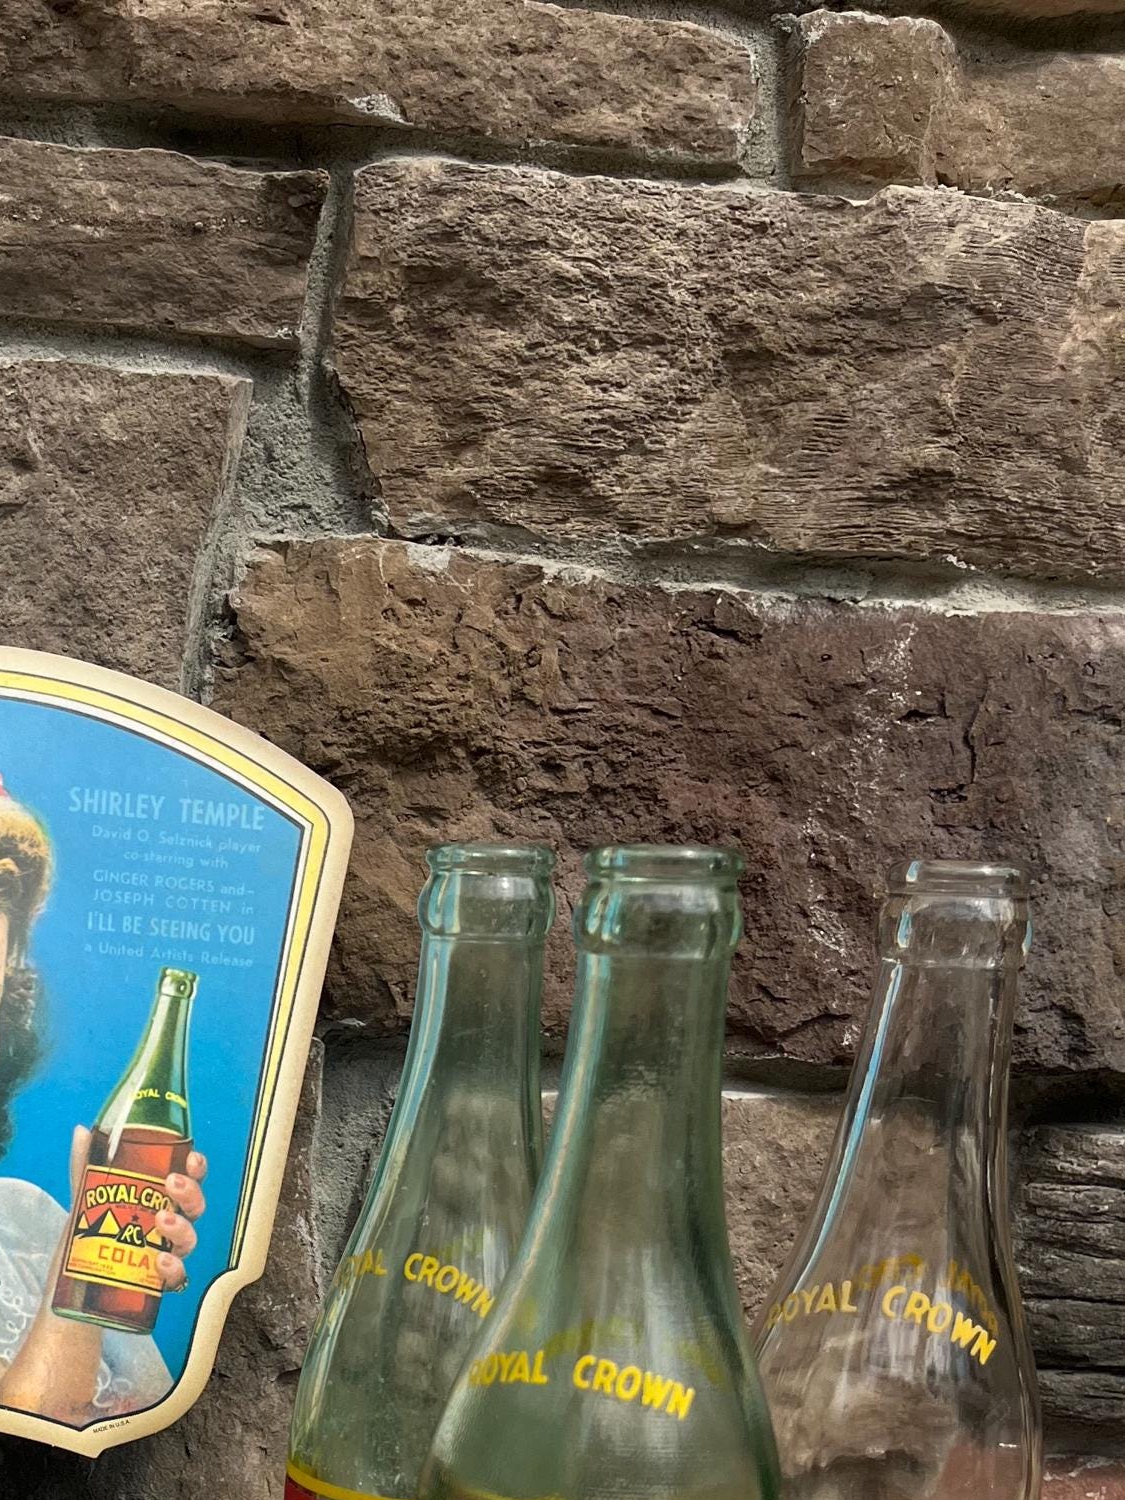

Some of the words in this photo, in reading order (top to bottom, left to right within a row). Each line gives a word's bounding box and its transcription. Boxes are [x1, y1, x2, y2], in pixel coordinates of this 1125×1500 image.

[69, 786, 165, 820] SHIRLEY
[179, 798, 266, 831] TEMPLE
[92, 825, 131, 840] David
[218, 839, 261, 854] player
[200, 856, 229, 869] with
[93, 869, 148, 886] GINGER
[154, 875, 215, 893] ROGERS
[93, 889, 155, 907] JOSEPH
[165, 897, 231, 914] COTTEN
[241, 902, 254, 915] in
[87, 911, 115, 932] I'LL
[122, 915, 143, 935] BE
[149, 918, 211, 942] SEEING
[217, 923, 255, 945] YOU
[98, 942, 144, 958] United
[149, 947, 194, 963] Artists
[200, 952, 254, 968] Release
[132, 1088, 160, 1100] OYAL
[86, 1184, 138, 1209] ROYAL
[141, 1187, 173, 1210] CRO
[121, 1224, 143, 1245] RC
[98, 1244, 150, 1270] COLA
[403, 1252, 495, 1319] CROWN
[765, 1280, 858, 1330] ROYAL
[881, 1286, 997, 1366] CROWN
[573, 1344, 696, 1421] CROWN
